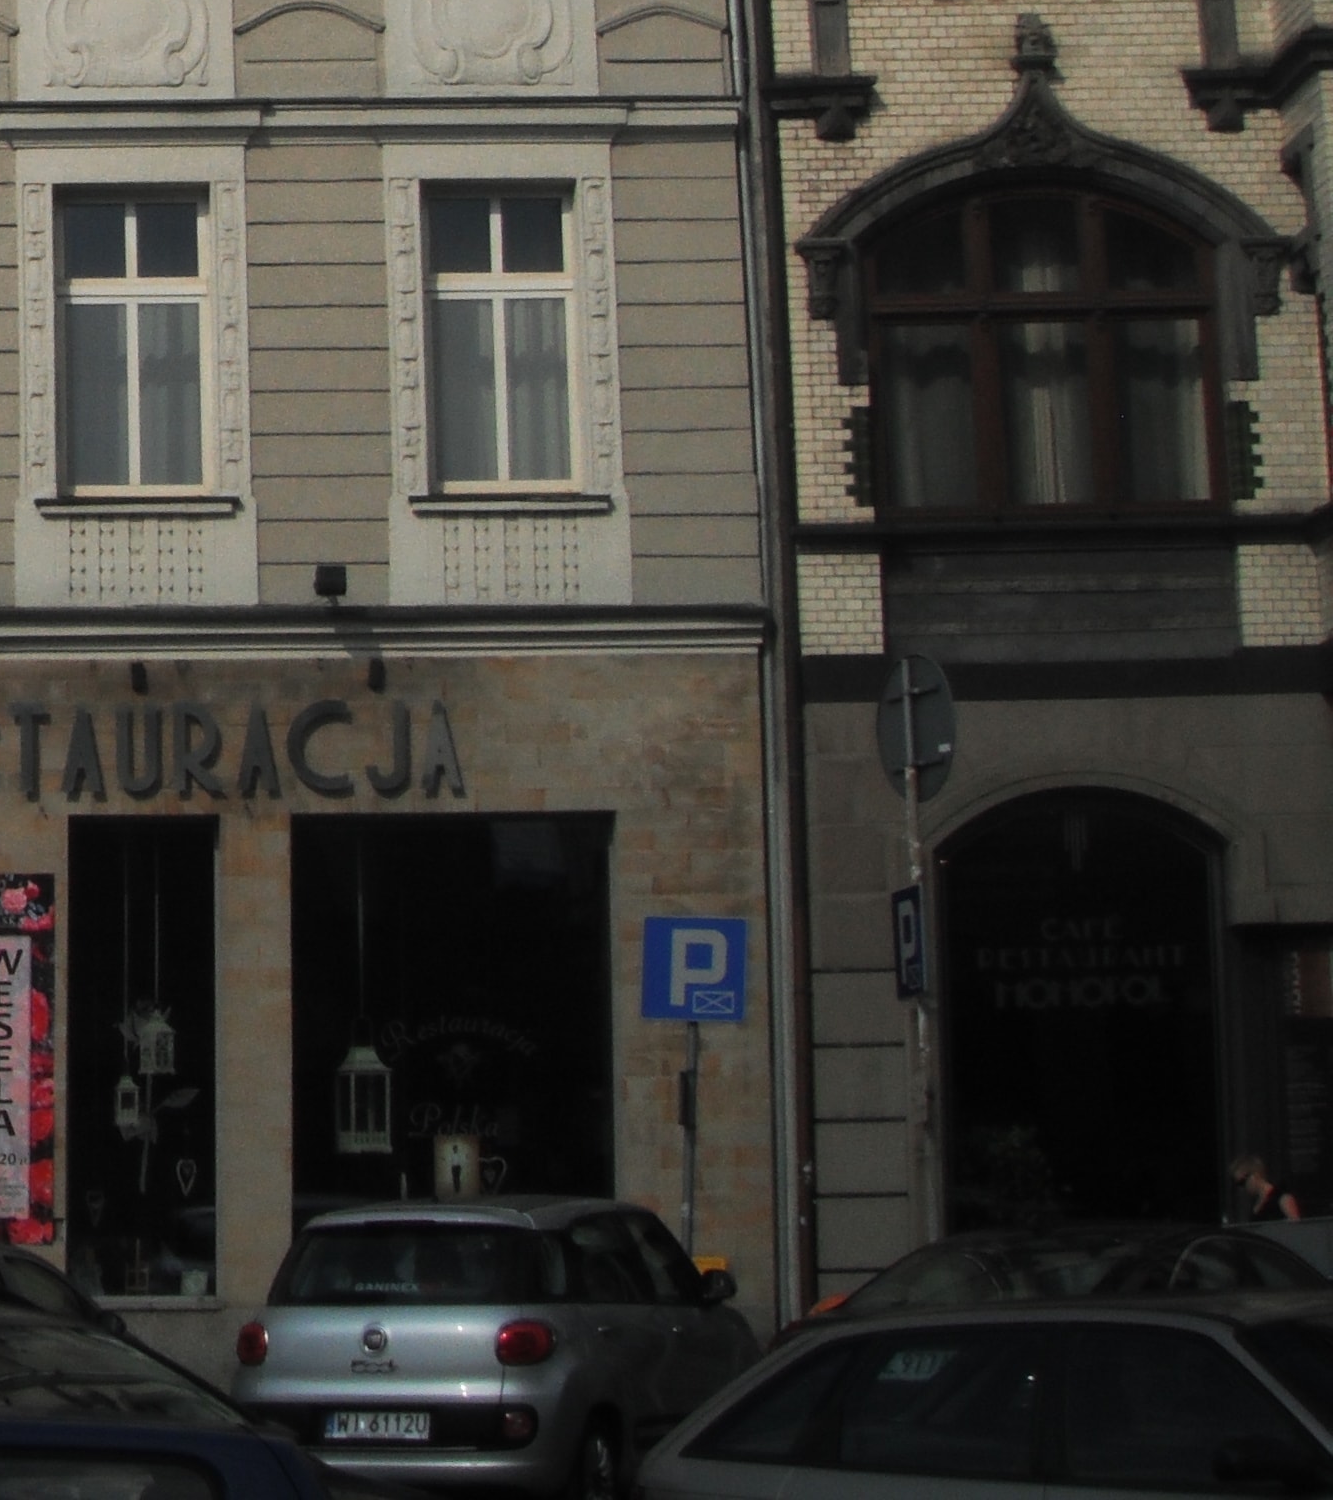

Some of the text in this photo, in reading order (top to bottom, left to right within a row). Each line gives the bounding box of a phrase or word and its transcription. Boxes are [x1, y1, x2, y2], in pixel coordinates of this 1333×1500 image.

[670, 929, 728, 1006] P
[380, 1014, 538, 1062] Restauracja
[408, 1102, 500, 1138] Polska
